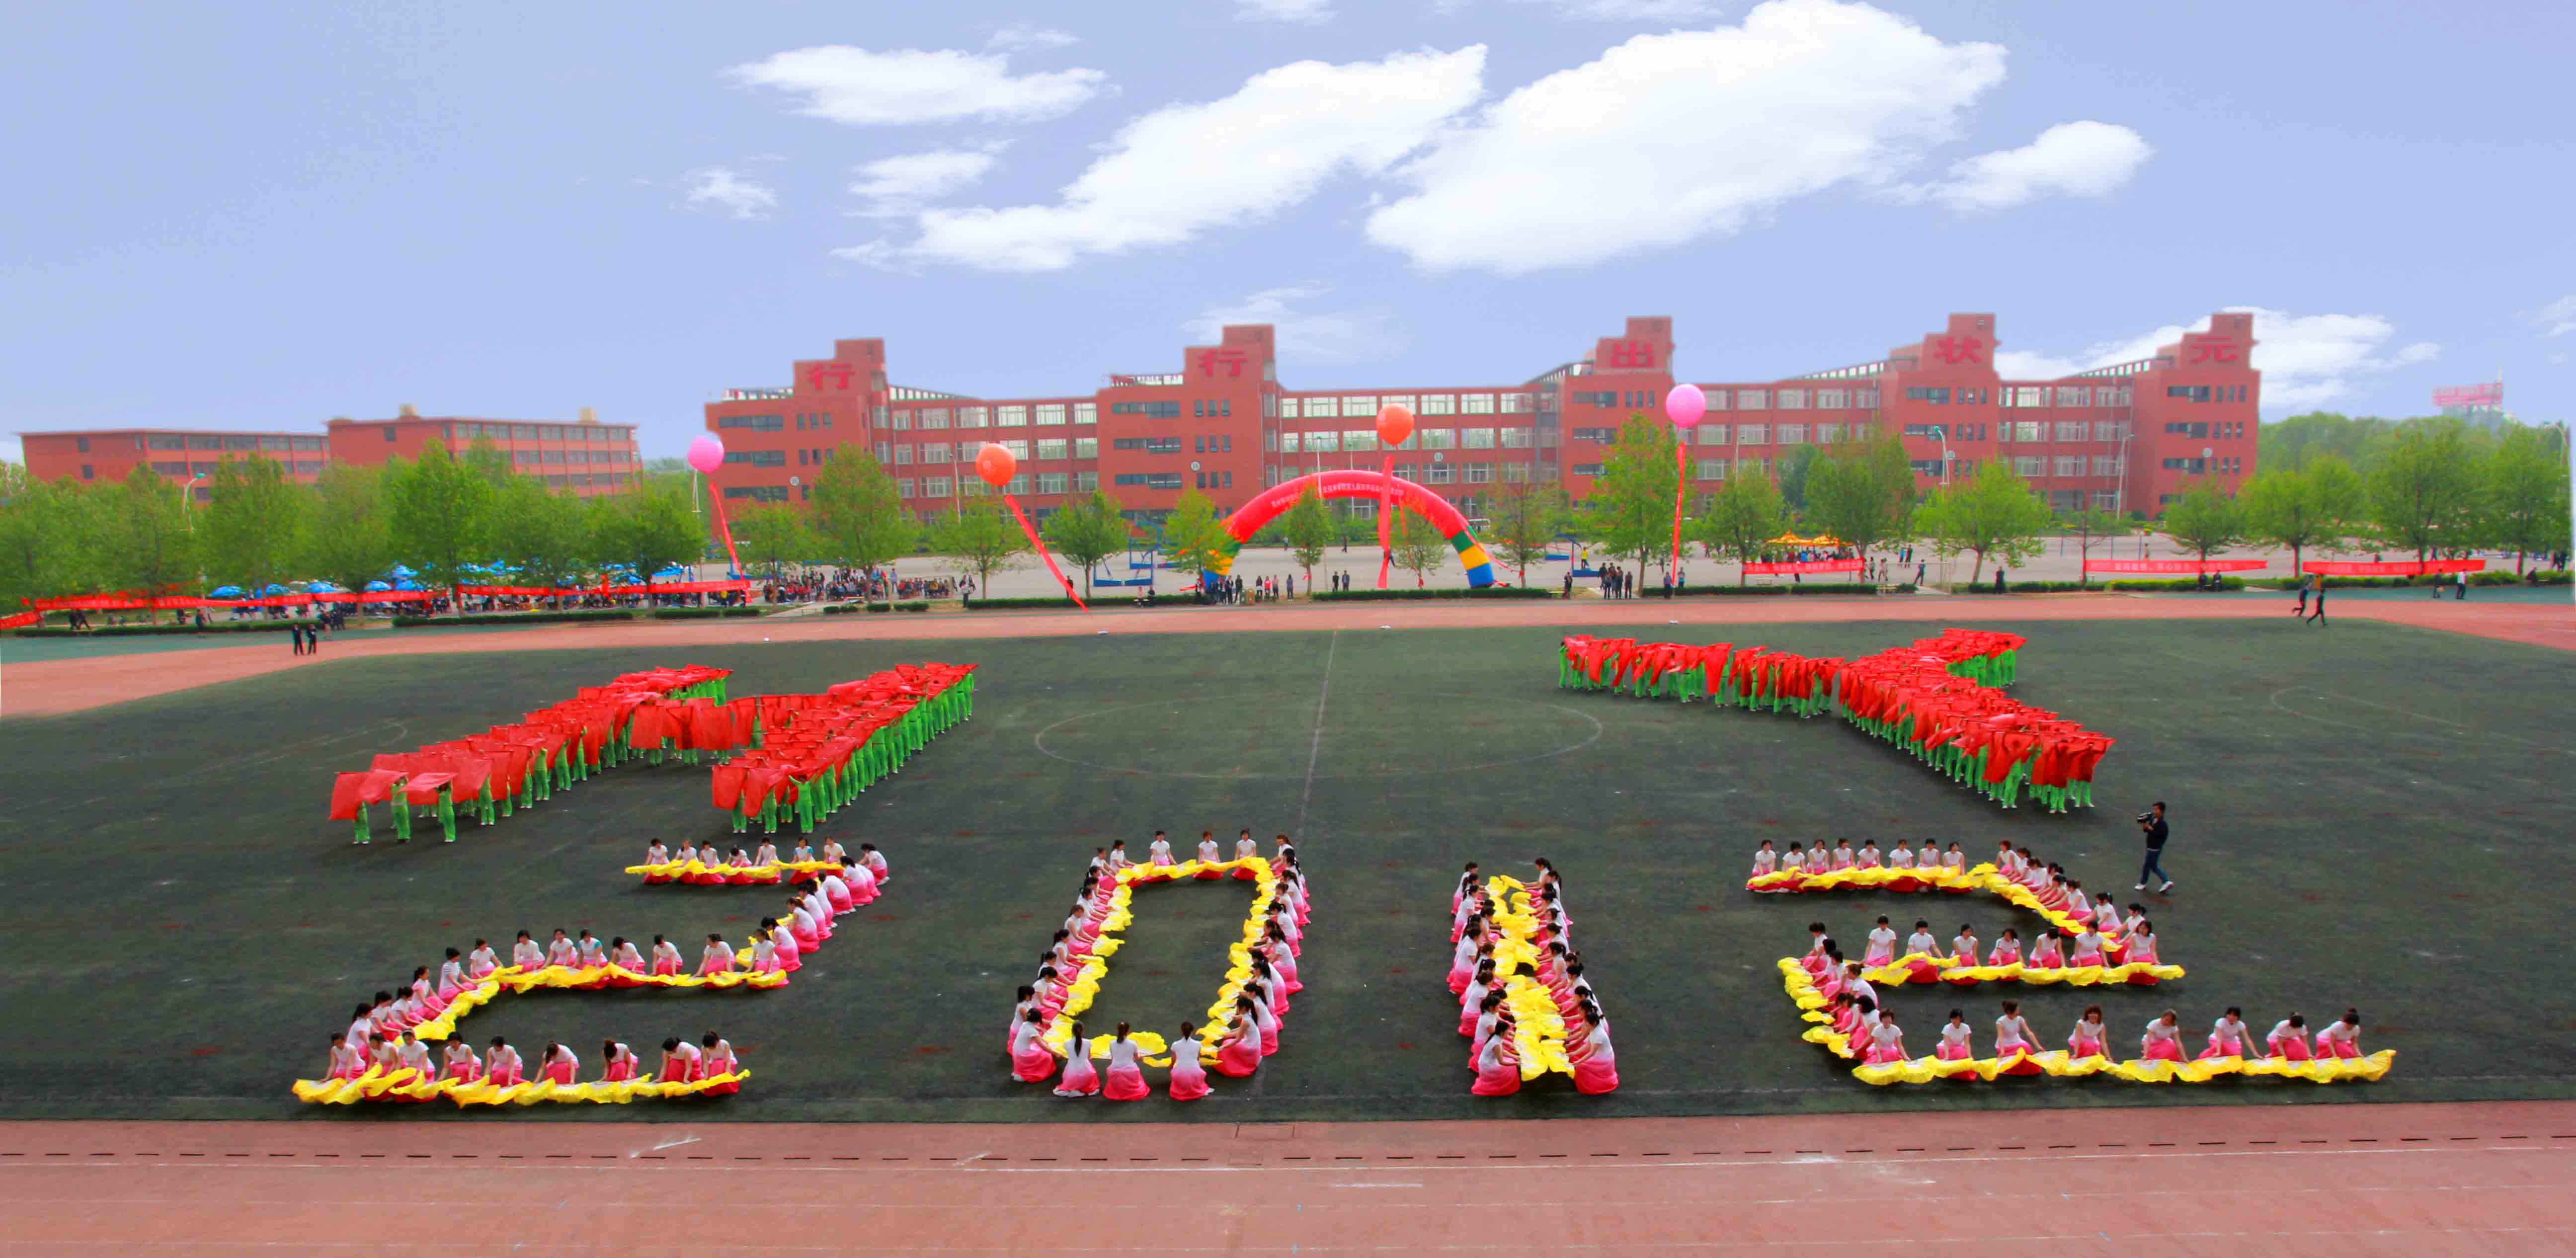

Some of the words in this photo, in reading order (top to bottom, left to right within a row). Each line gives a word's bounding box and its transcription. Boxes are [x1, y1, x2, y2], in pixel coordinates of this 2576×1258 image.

[807, 363, 855, 390] 行
[1199, 349, 1248, 377] 行
[1611, 341, 1654, 368] 出
[1933, 337, 1983, 363] 状
[2190, 335, 2239, 362] 元
